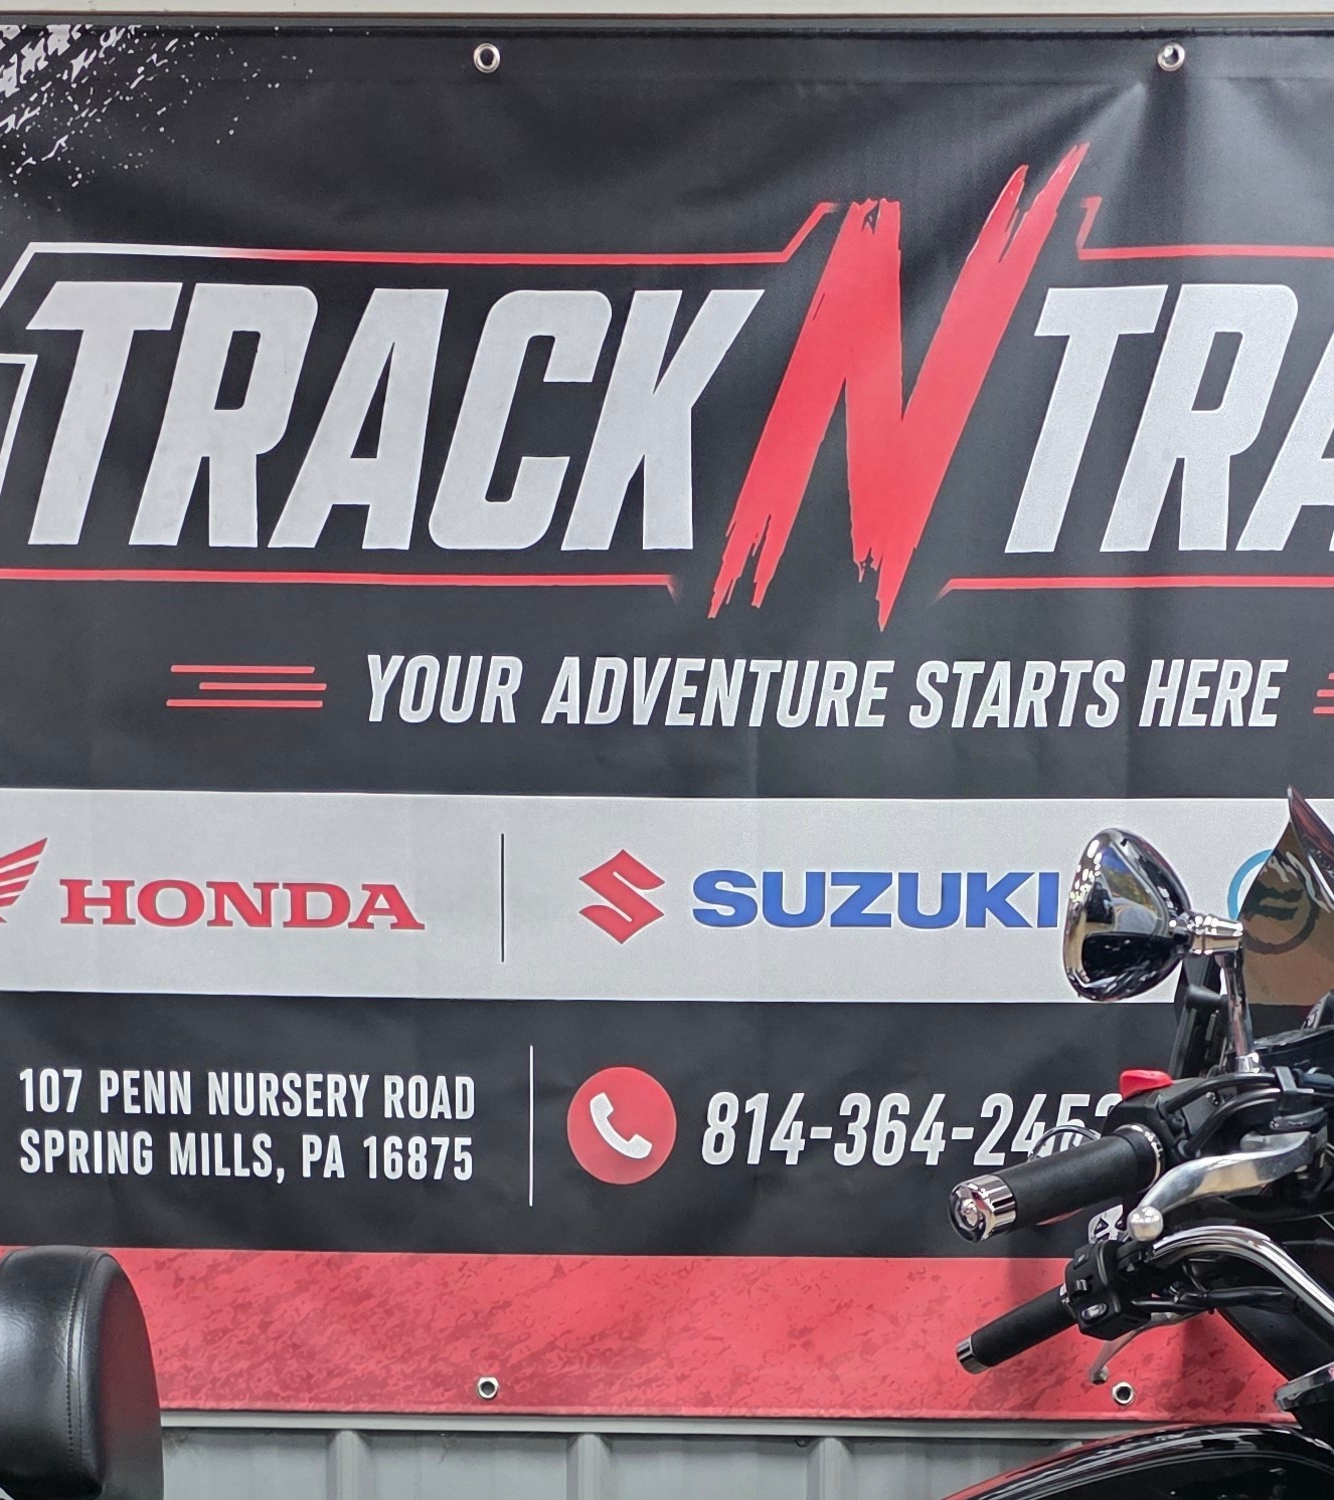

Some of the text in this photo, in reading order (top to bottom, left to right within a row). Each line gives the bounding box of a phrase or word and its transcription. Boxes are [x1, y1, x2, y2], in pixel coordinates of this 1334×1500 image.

[26, 281, 765, 551] TRACK
[709, 142, 1089, 631] N
[367, 655, 1290, 728] YOUR ADVENTURE STARTS HERE
[60, 879, 425, 930] HONDA
[692, 869, 1059, 929] SUZUKI
[19, 1067, 475, 1120] 107 PENN NURSERY ROAD
[20, 1128, 473, 1184] SPRING MILLS, PA 16875
